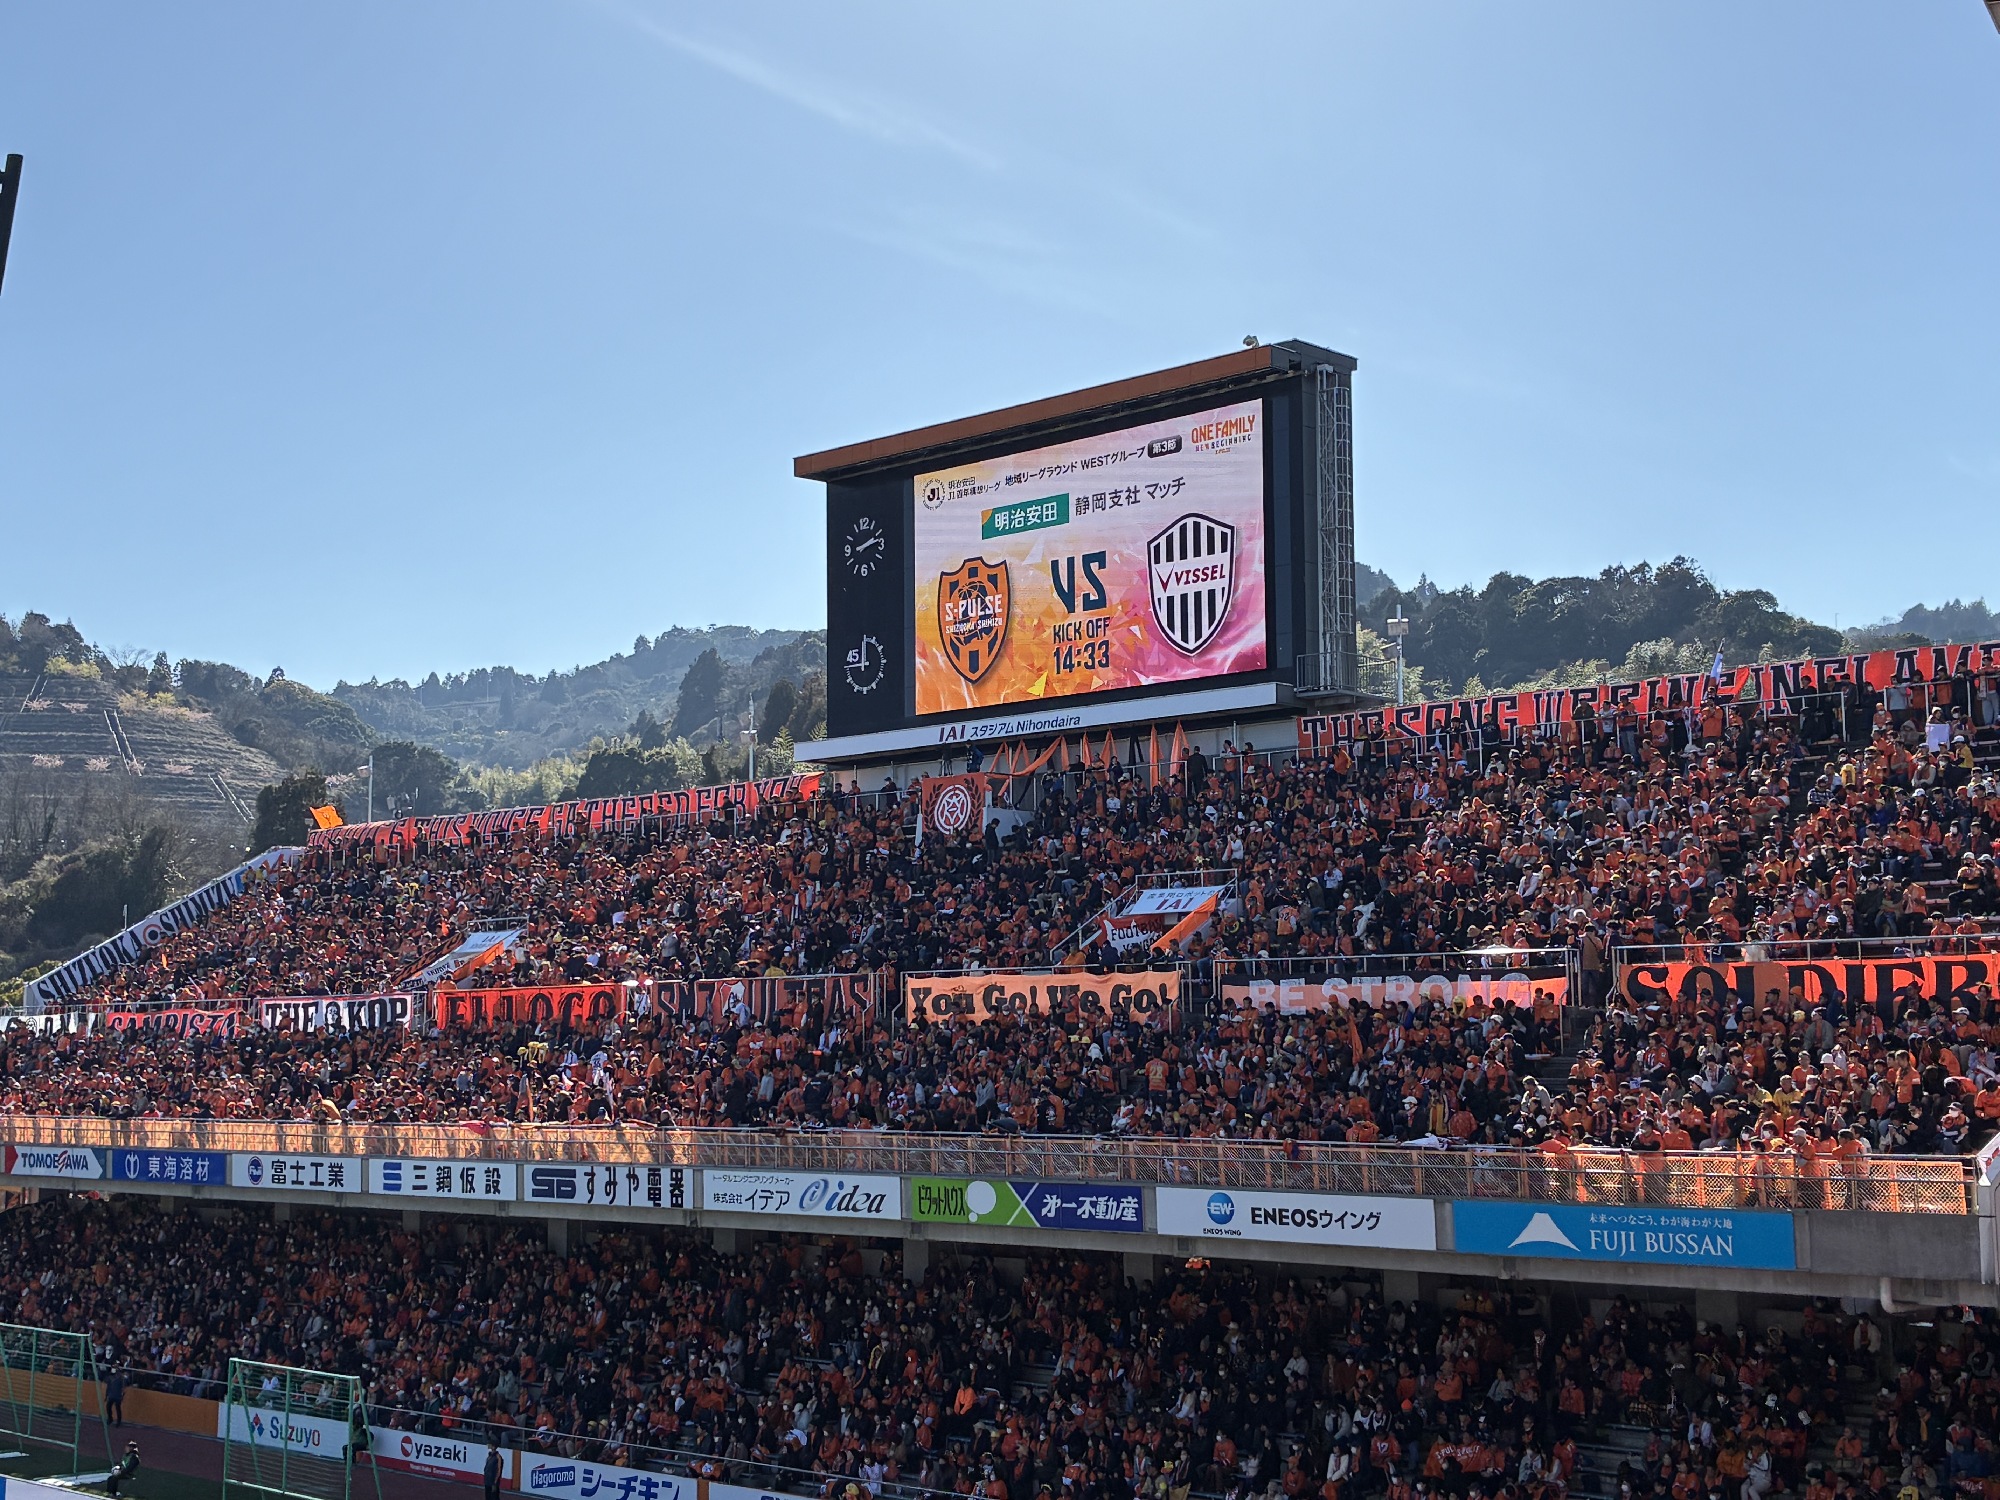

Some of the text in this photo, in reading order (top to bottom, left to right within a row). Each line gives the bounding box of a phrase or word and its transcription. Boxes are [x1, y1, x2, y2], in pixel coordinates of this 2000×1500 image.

[1191, 414, 1256, 444] ONE FAMILY
[1005, 461, 1078, 486] 地域リーグラウンド
[1080, 446, 1146, 471] WESTグループ
[1074, 476, 1186, 516] 静岡支社 マッチ
[860, 517, 869, 530] 12
[994, 501, 1058, 531] 明治安田
[844, 538, 885, 557] 9 3
[860, 564, 868, 577] 6
[1050, 550, 1107, 614] VS
[1174, 563, 1226, 586] VISSEL
[945, 593, 1003, 622] S-PULSE
[1053, 616, 1111, 645] KICK OFF
[846, 649, 859, 662] 45
[1053, 639, 1110, 675] 14:33
[938, 715, 1081, 743] IAI スタジアム Nihondaira
[1154, 898, 1195, 911] IAI
[910, 986, 976, 1015] You
[982, 983, 1038, 1014] Go!
[1110, 982, 1168, 1014] Go!
[1249, 977, 1306, 1016] BE
[265, 997, 408, 1033] THE KOP
[21, 1150, 89, 1173] TOMOEGAWA
[148, 1154, 210, 1182] 東海溶材
[271, 1159, 345, 1188] 富士工業
[412, 1165, 502, 1195] 三鋼仮設
[583, 1166, 684, 1208] すみや電器
[713, 1188, 790, 1211] 株式会社 イデア
[825, 1180, 887, 1214] idea
[918, 1184, 966, 1216] ピタットハウス
[1250, 1207, 1382, 1231] ENEOSウイング
[1589, 1229, 1733, 1257] FUJI BUSSAN
[269, 1415, 321, 1448] Suzuyo
[415, 1442, 467, 1464] yazaki
[532, 1468, 575, 1488] Hagoromo
[580, 1468, 681, 1500] シーチキン
